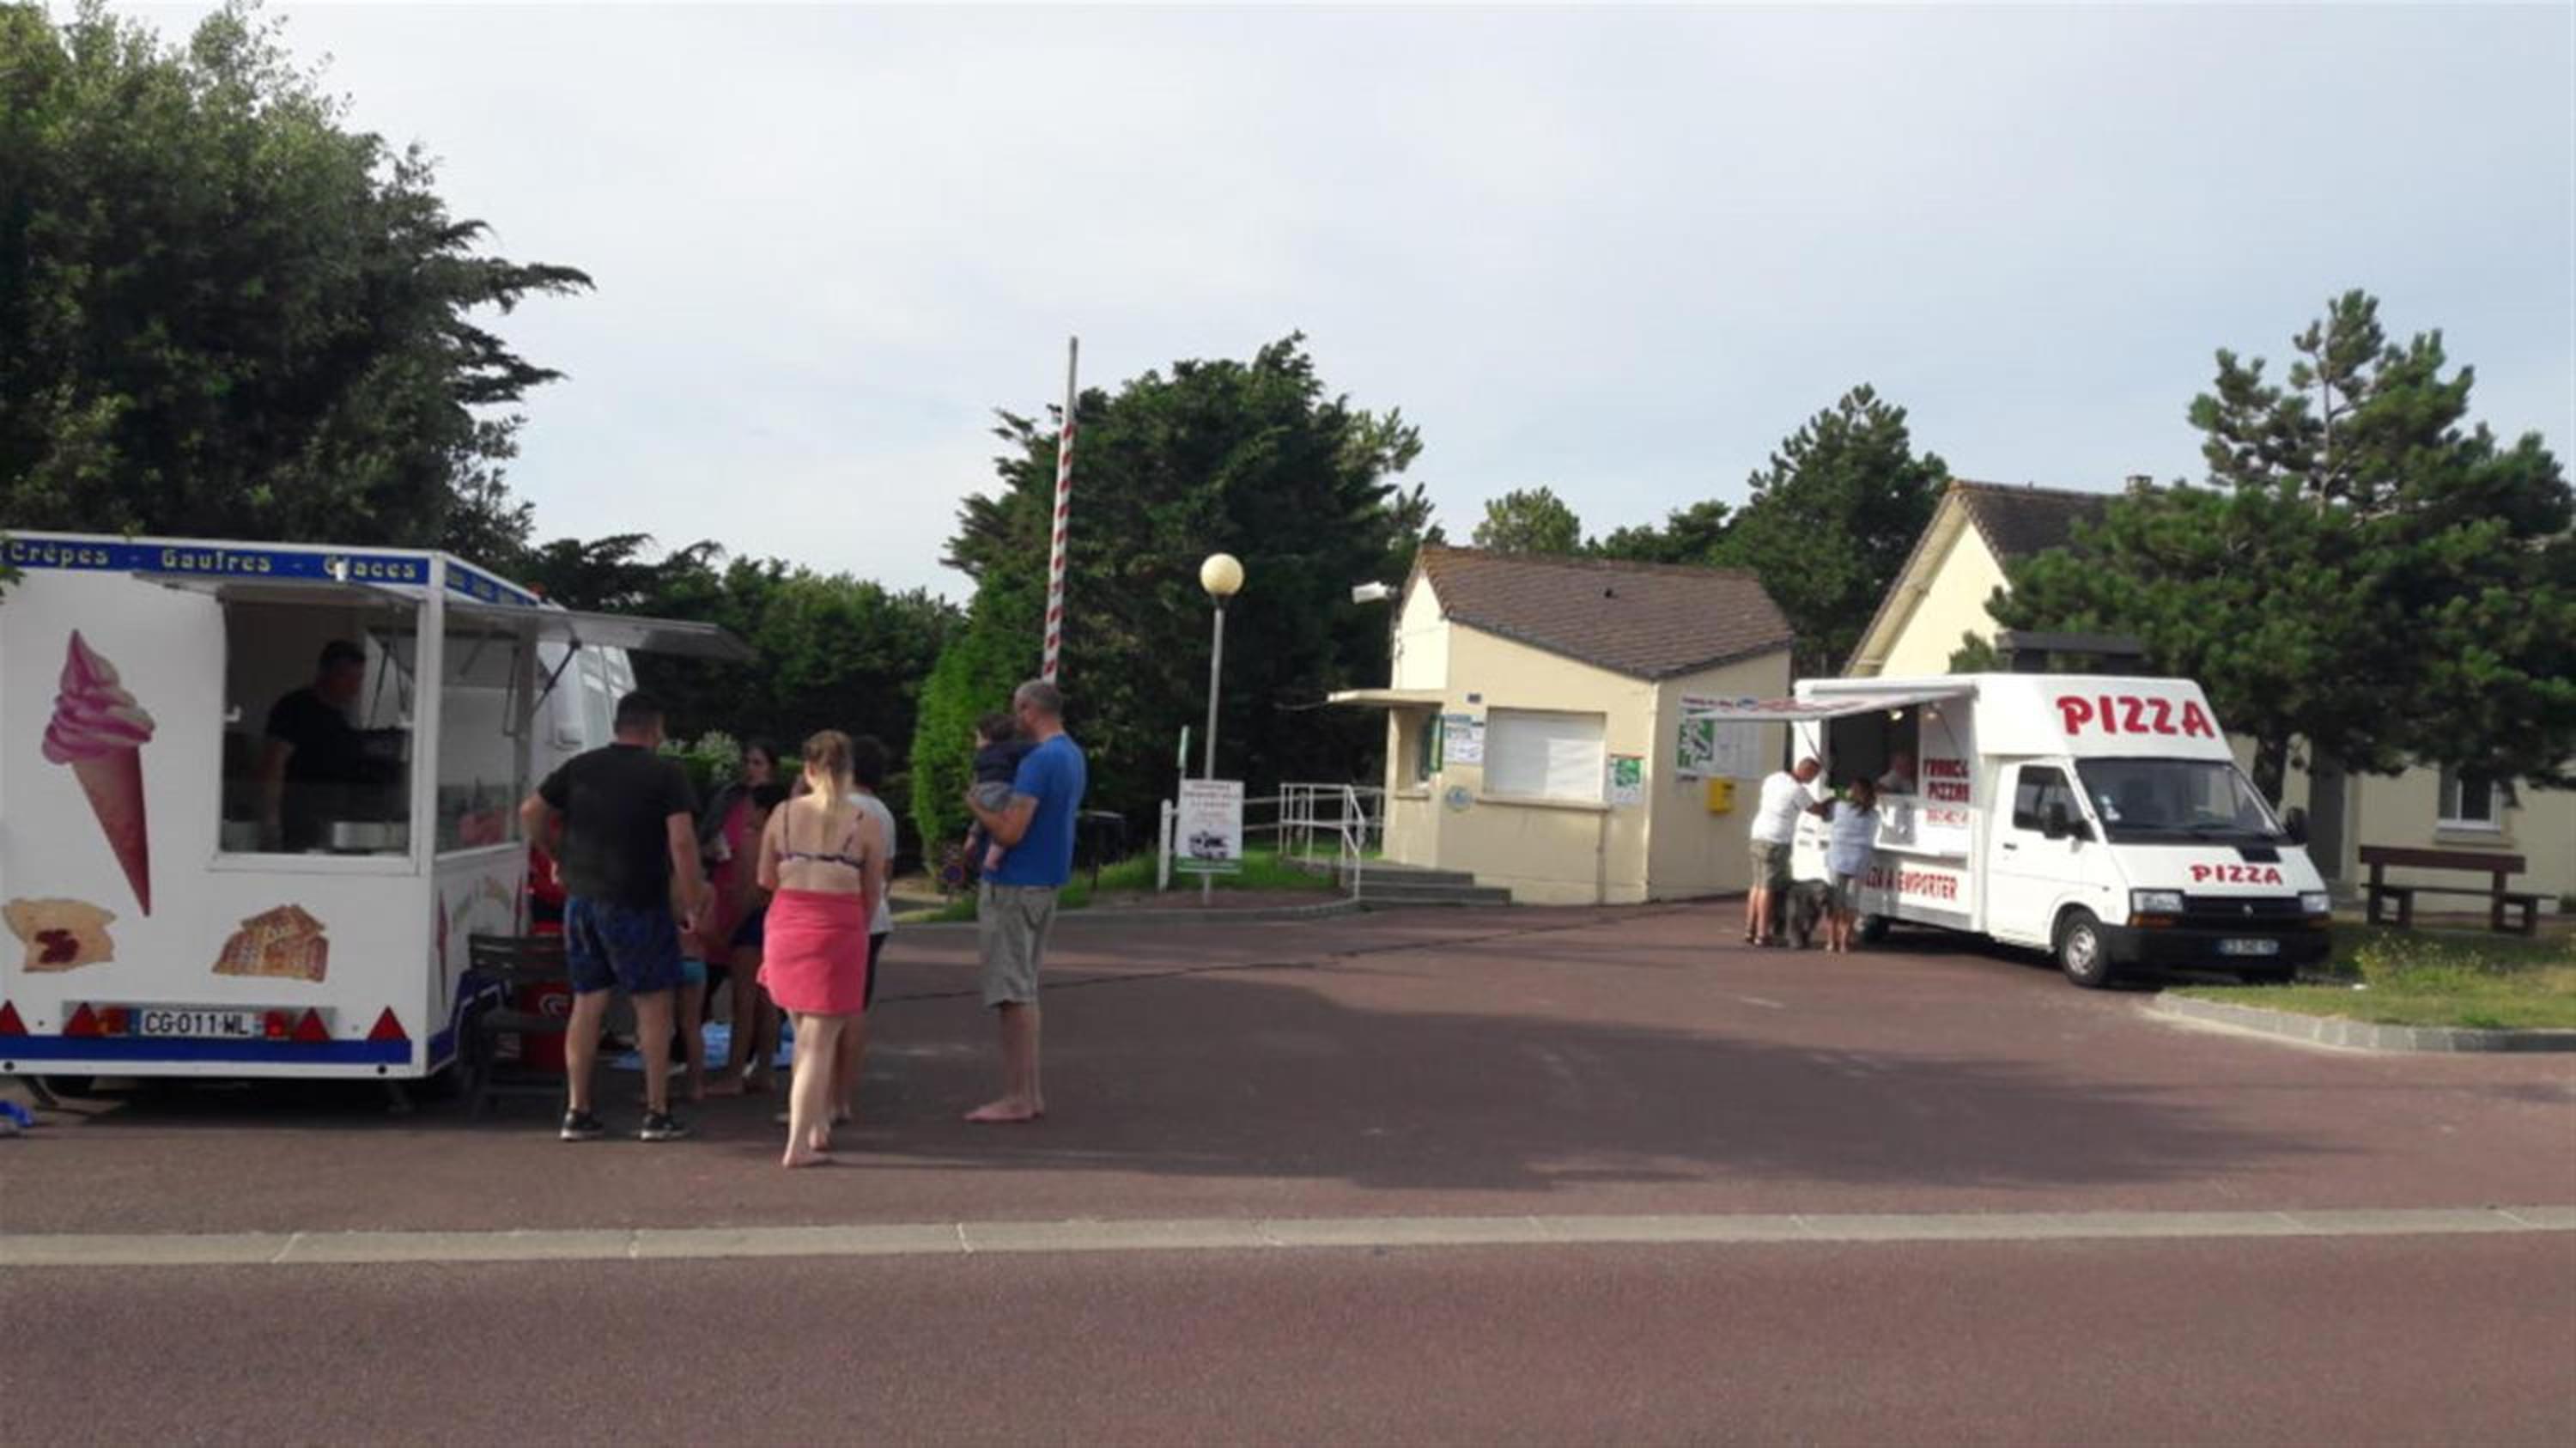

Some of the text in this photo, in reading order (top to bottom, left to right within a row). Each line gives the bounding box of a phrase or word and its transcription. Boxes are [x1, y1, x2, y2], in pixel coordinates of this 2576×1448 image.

[161, 549, 271, 573] Gaufres
[2057, 696, 2215, 739] PIZZA
[2190, 864, 2283, 885] PIZZA
